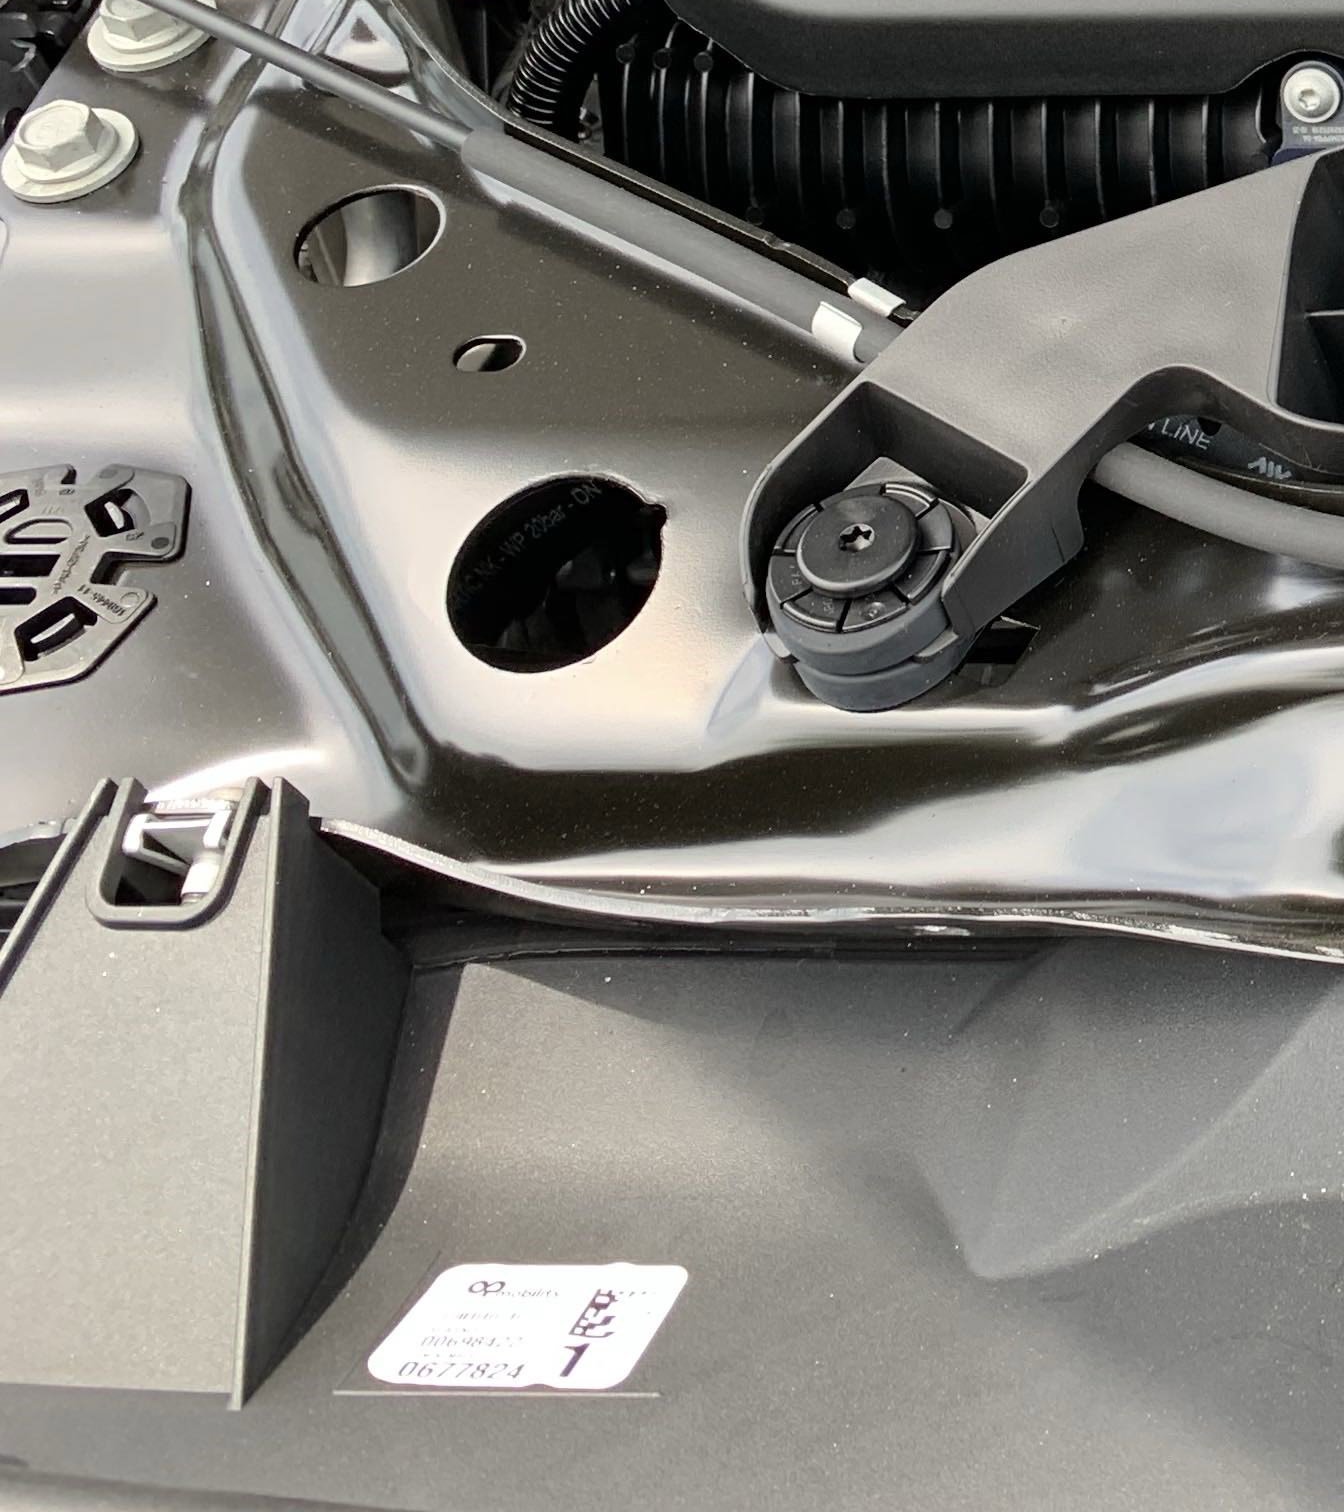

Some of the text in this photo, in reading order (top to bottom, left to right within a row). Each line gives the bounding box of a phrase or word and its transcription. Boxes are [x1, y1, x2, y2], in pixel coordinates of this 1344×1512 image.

[1161, 418, 1211, 450] LINE
[398, 1362, 526, 1379] 0677824
[559, 1343, 590, 1377] 1
